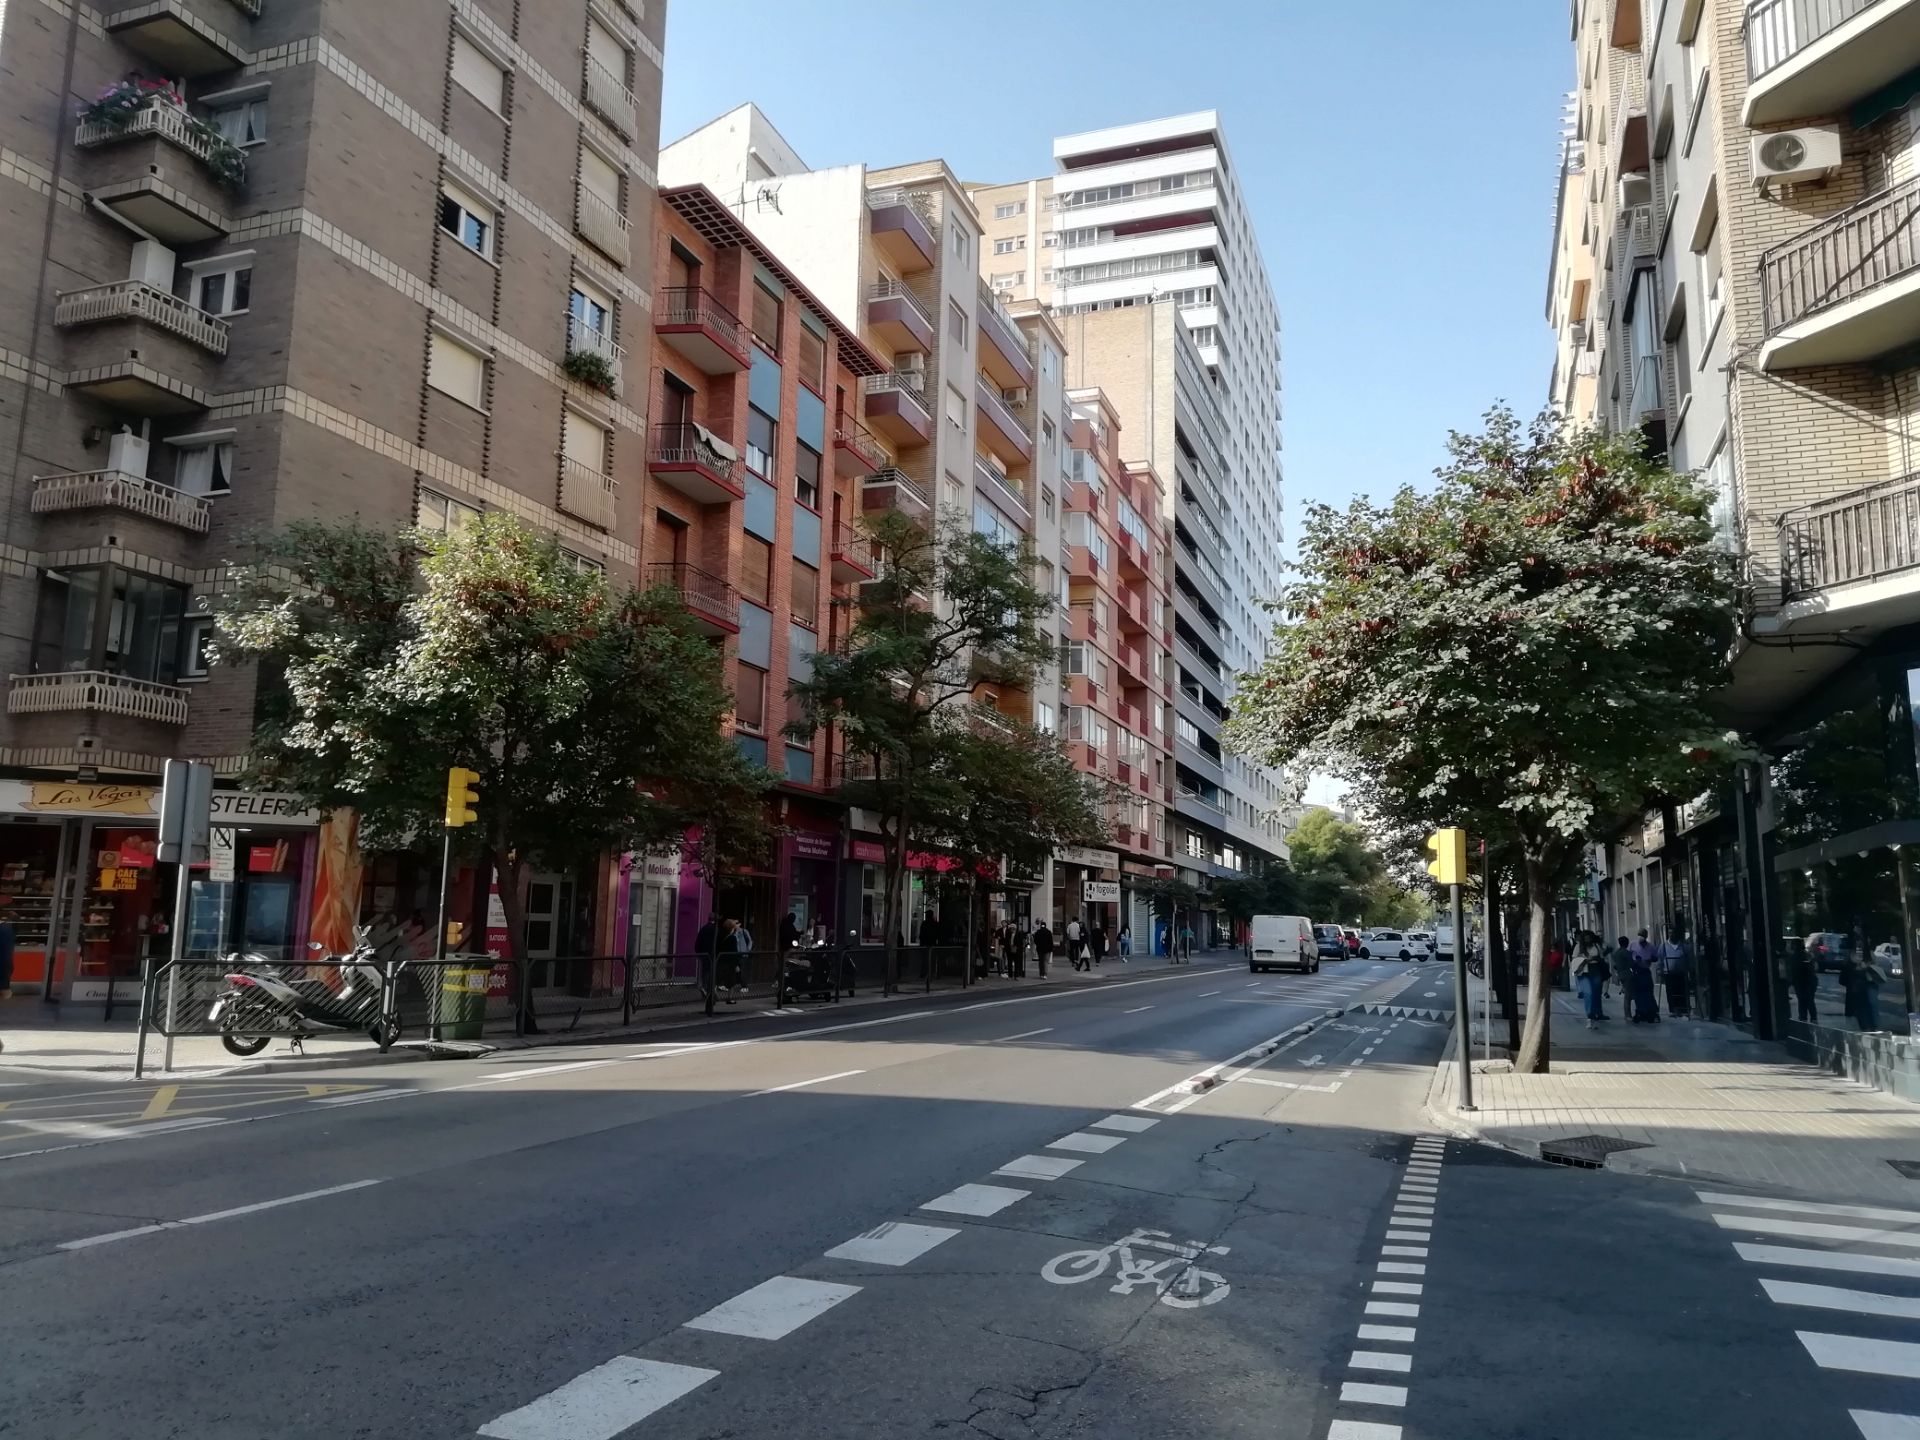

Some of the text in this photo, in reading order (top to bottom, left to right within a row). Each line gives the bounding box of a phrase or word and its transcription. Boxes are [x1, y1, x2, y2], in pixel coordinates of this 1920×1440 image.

[38, 785, 141, 808] Las Vegas
[210, 795, 308, 816] STELERA
[648, 864, 675, 875] Moliner
[86, 990, 130, 998] Choclate
